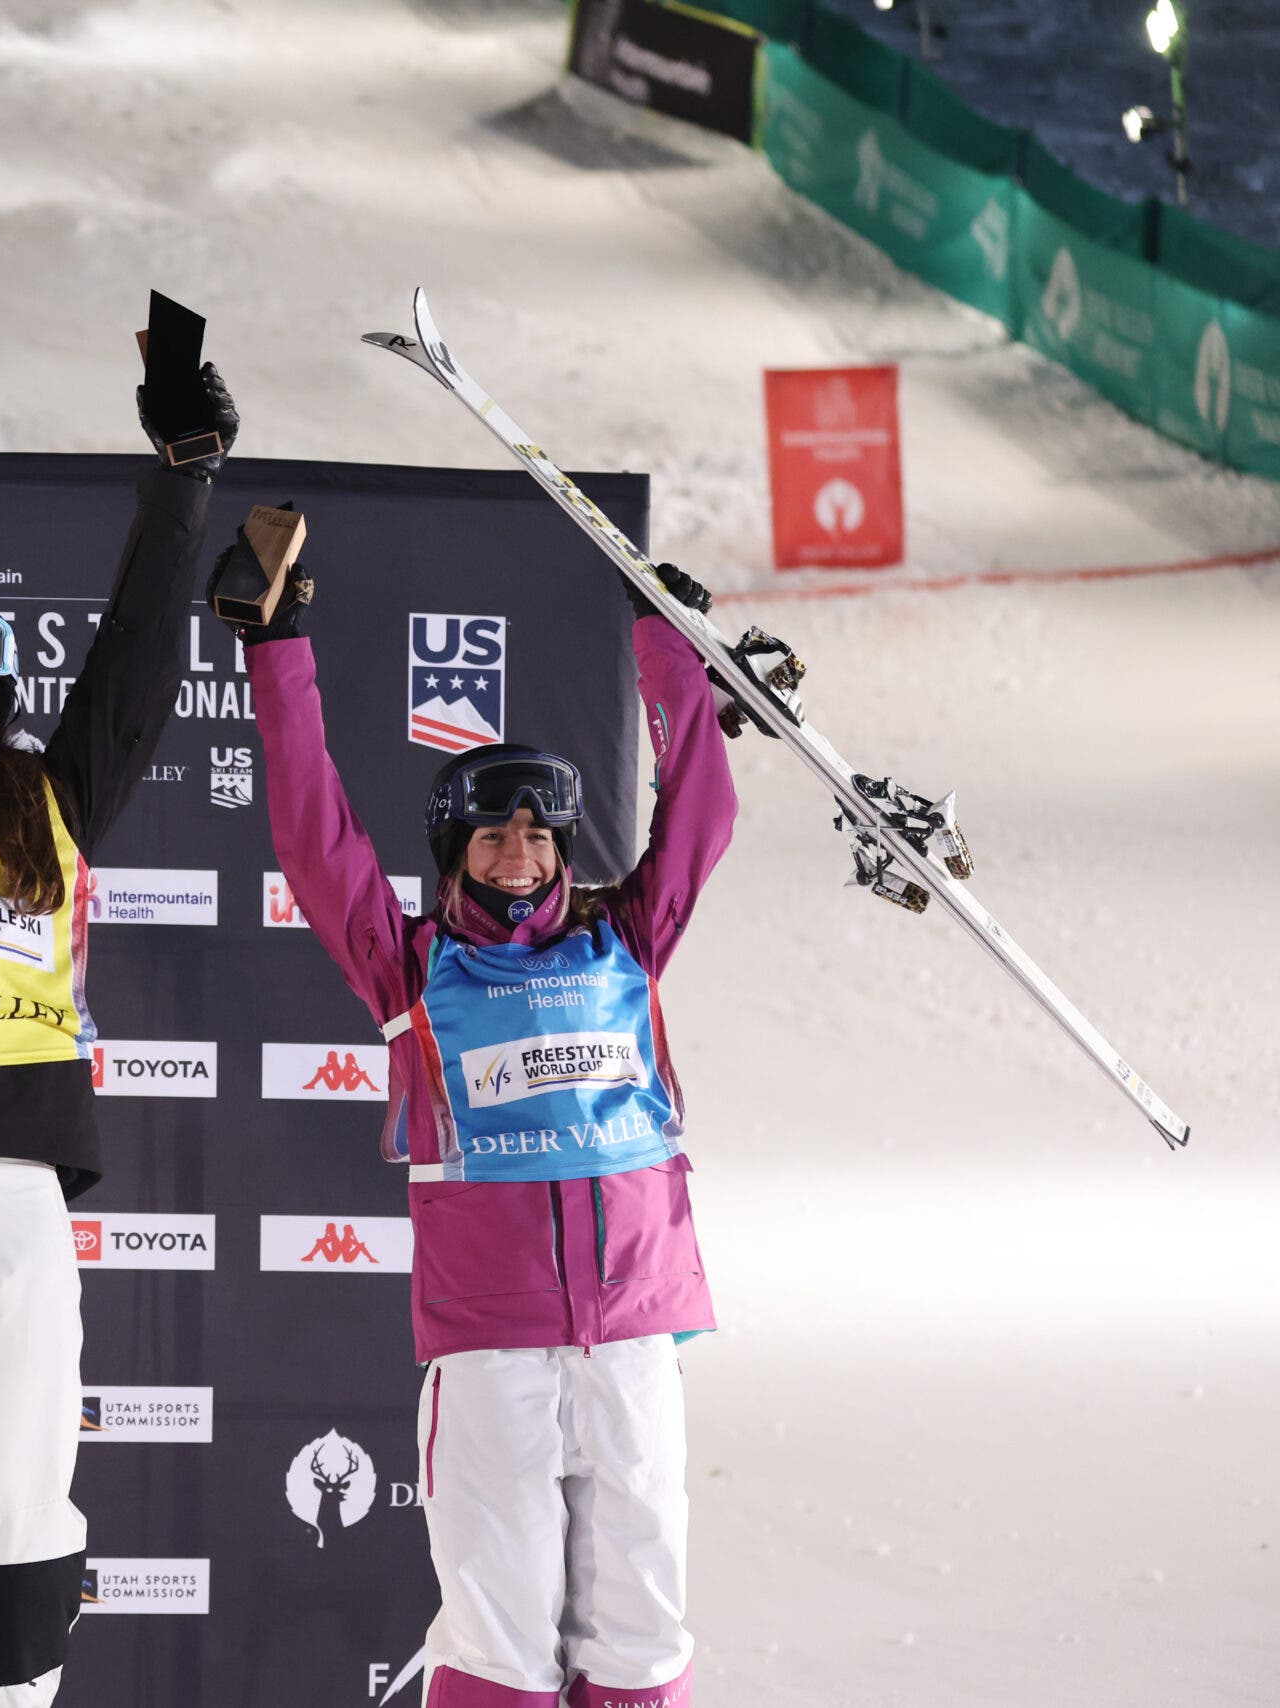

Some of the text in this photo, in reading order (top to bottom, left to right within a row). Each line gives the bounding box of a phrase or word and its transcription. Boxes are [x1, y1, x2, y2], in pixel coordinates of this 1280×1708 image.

[412, 616, 502, 666] US
[210, 746, 253, 768] US
[142, 765, 186, 781] LEY
[108, 890, 213, 905] Intermountain
[108, 906, 155, 919] Health
[19, 911, 42, 936] SKI
[487, 971, 608, 1000] Intermountain
[528, 991, 585, 1010] Health
[521, 1045, 613, 1066] FREESTYLE
[113, 1058, 209, 1079] TOYOTA
[525, 1060, 604, 1079] WORLD CUP
[471, 1110, 657, 1155] DEER VALLEY
[110, 1231, 207, 1251] TOYOTA
[106, 1403, 200, 1414] UTAH SPORTS
[105, 1416, 198, 1427] COMMISSION
[102, 1575, 197, 1586] UTAH SPORTS
[102, 1588, 195, 1599] COMMISSION
